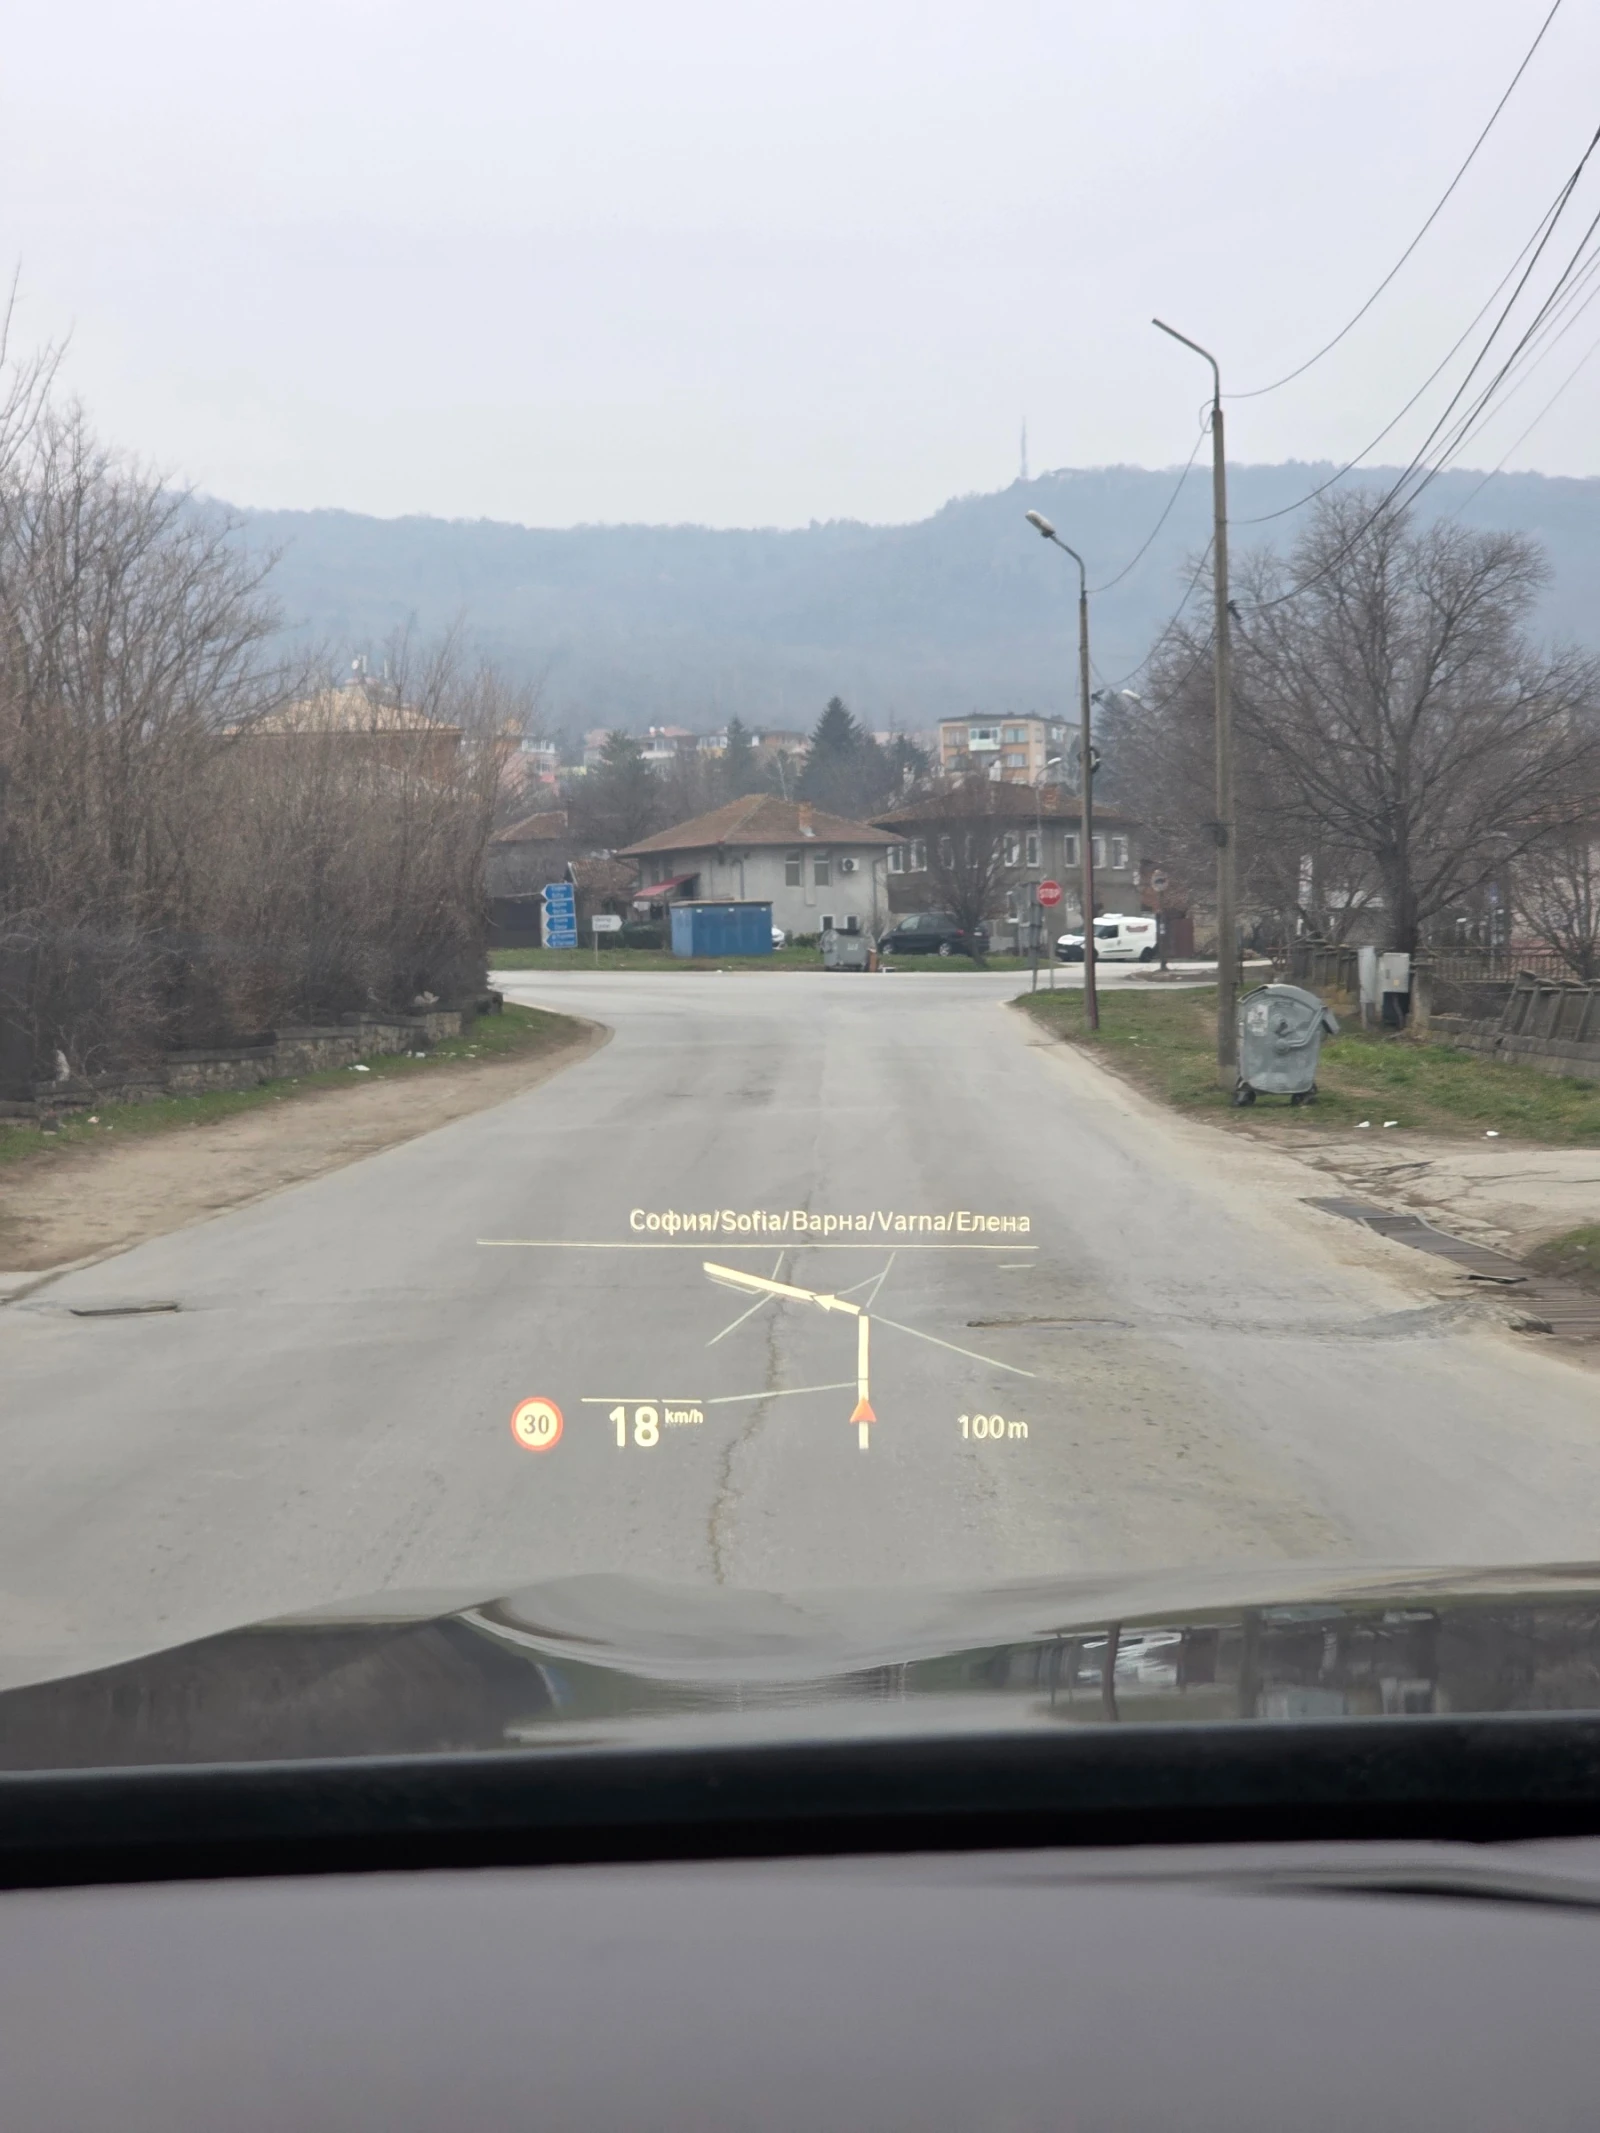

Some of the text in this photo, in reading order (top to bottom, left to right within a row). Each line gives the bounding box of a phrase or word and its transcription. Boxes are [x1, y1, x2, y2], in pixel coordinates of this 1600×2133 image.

[523, 1414, 550, 1435] 30
[608, 1405, 704, 1447] 18 km/h
